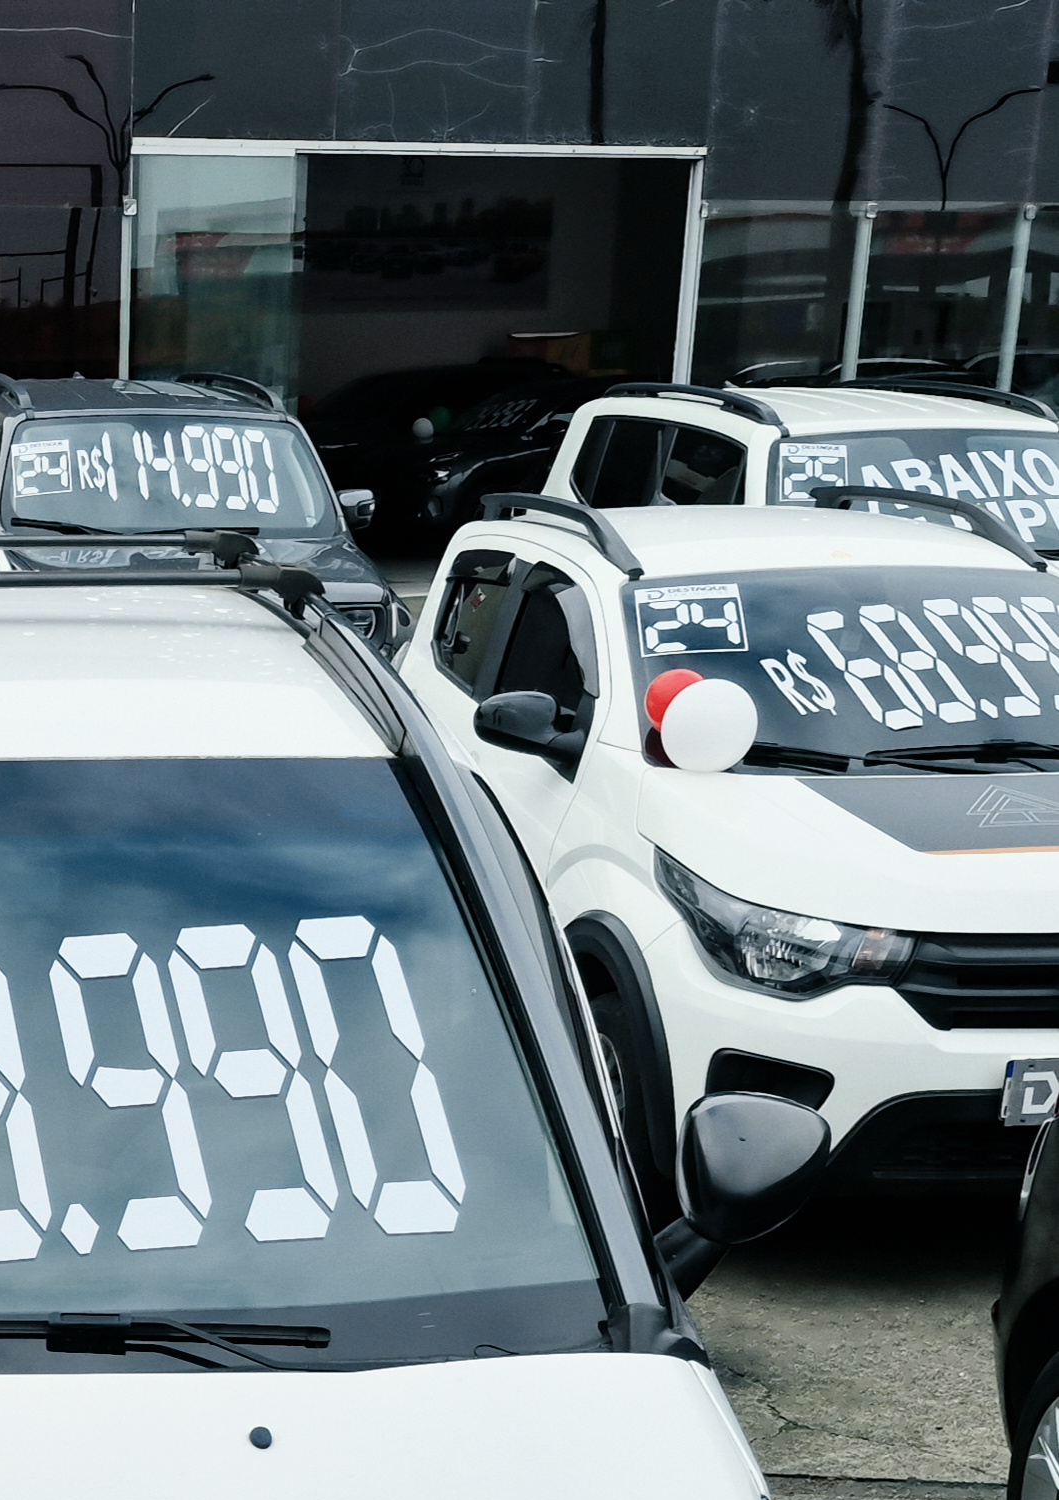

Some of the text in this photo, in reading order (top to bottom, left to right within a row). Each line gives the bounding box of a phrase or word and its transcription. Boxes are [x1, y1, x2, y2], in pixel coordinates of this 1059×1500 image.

[16, 454, 68, 494] 24
[76, 425, 279, 514] R$ 114.990
[667, 585, 728, 594] DESTAQUE
[644, 600, 742, 653] 24
[759, 648, 838, 716] R$
